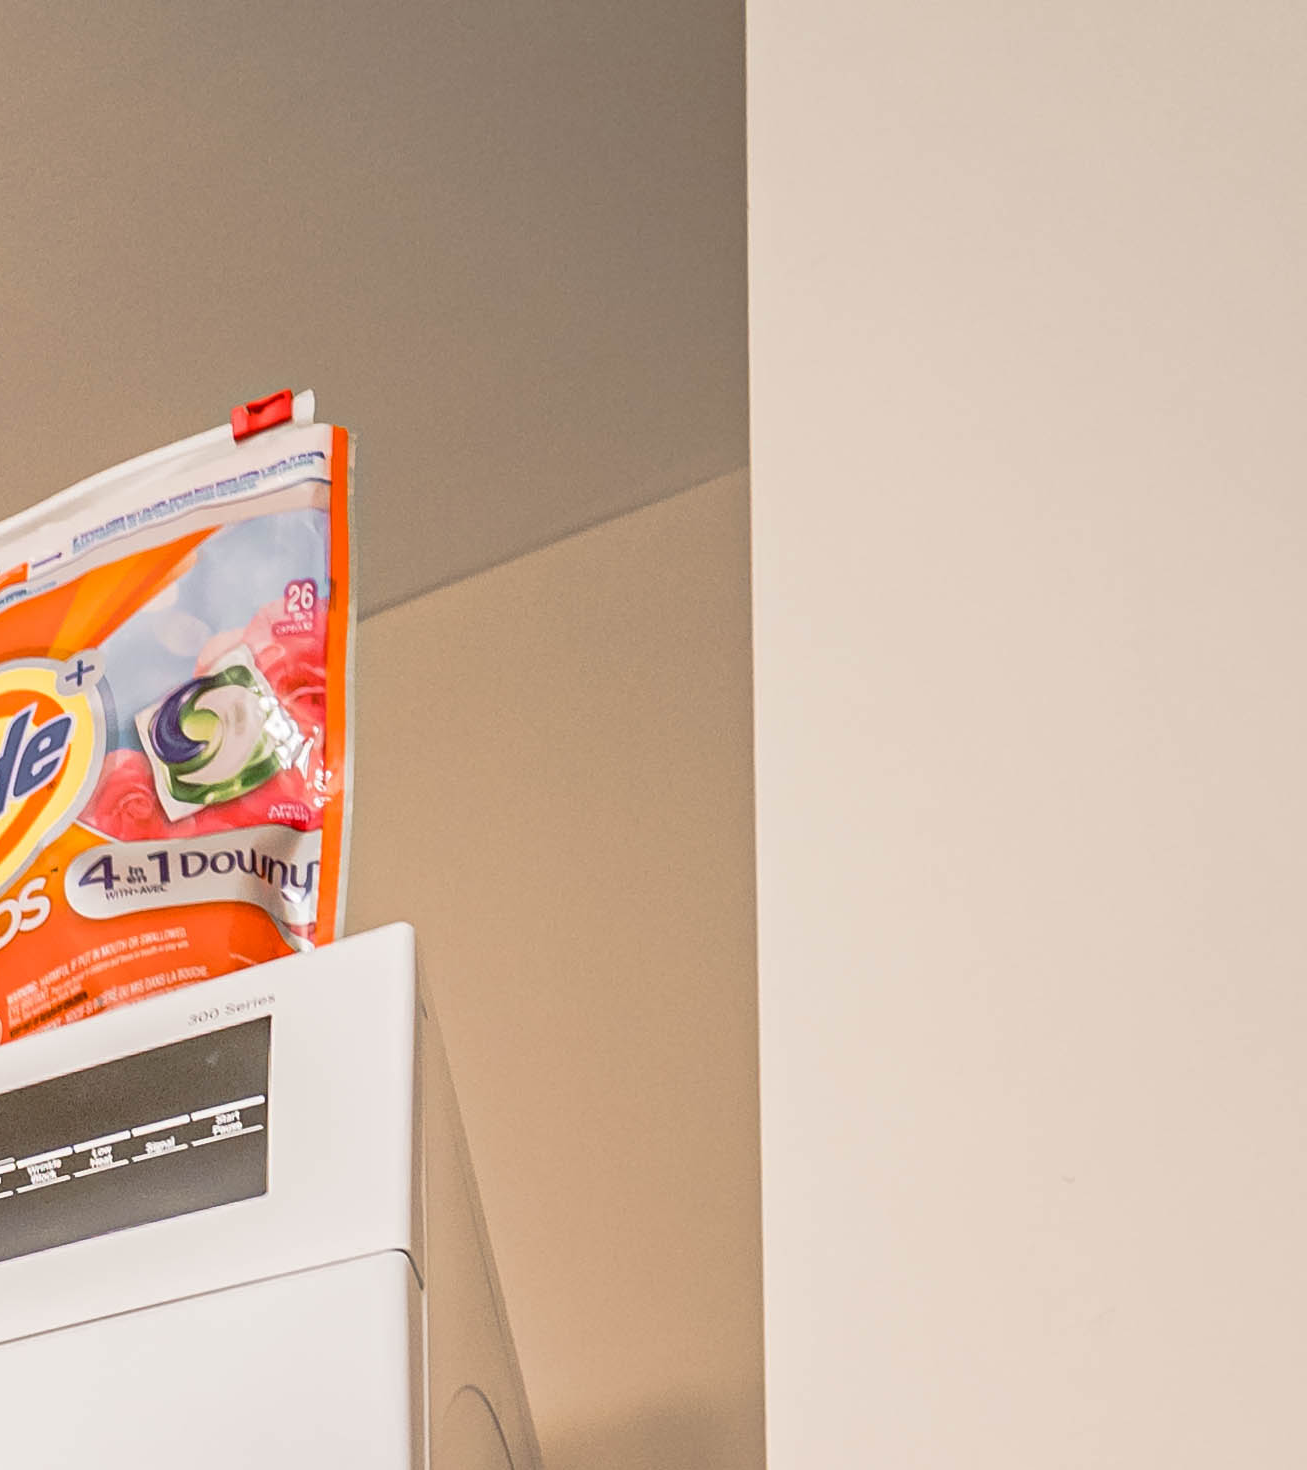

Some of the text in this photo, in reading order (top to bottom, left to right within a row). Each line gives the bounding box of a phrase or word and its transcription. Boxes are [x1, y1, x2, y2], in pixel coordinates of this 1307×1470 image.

[287, 583, 314, 612] 26
[78, 854, 120, 890] 4
[148, 851, 171, 884] 1
[188, 993, 275, 1026] 300 Series
